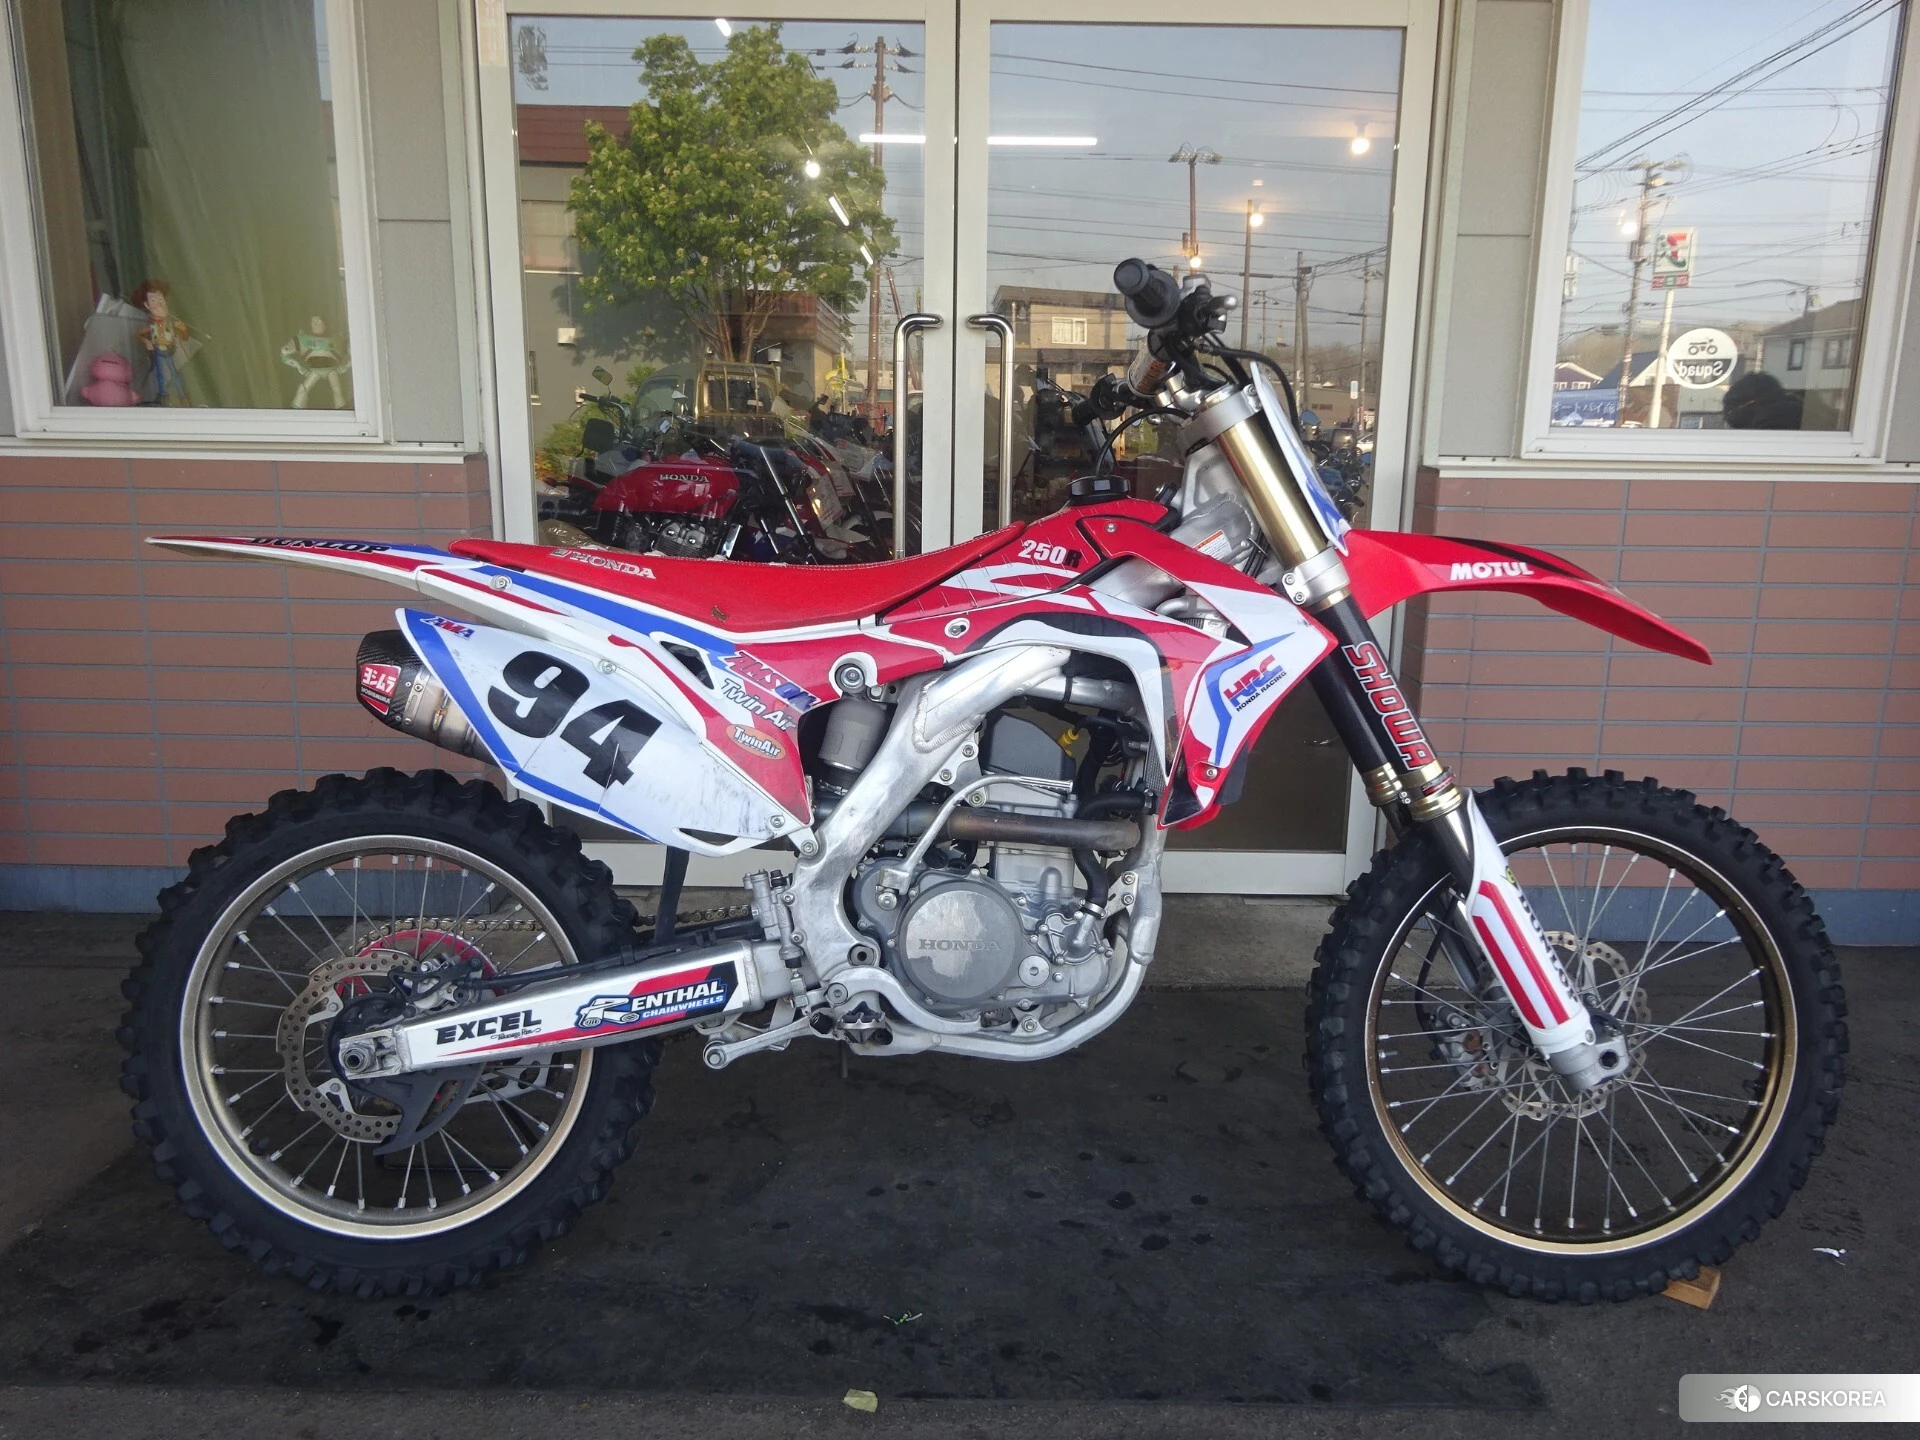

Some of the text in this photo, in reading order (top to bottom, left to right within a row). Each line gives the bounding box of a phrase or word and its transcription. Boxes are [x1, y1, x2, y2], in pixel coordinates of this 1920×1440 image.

[659, 474, 709, 483] HONDA
[251, 537, 392, 554] DUNLOP
[570, 551, 656, 580] HONDA
[1450, 562, 1534, 581] MOTUL
[421, 616, 475, 640] AMA
[362, 666, 397, 694] ヨシムラ
[1223, 654, 1284, 708] HRC
[1236, 671, 1287, 712] HONDA RACING
[721, 678, 797, 731] Twin Air
[1341, 640, 1436, 770] SHOWA
[487, 650, 663, 789] 94
[733, 726, 781, 758] TwinAir
[918, 938, 1003, 952] HONDA
[642, 994, 724, 1019] CHAINWHEELS
[435, 1009, 542, 1045] EXCEL
